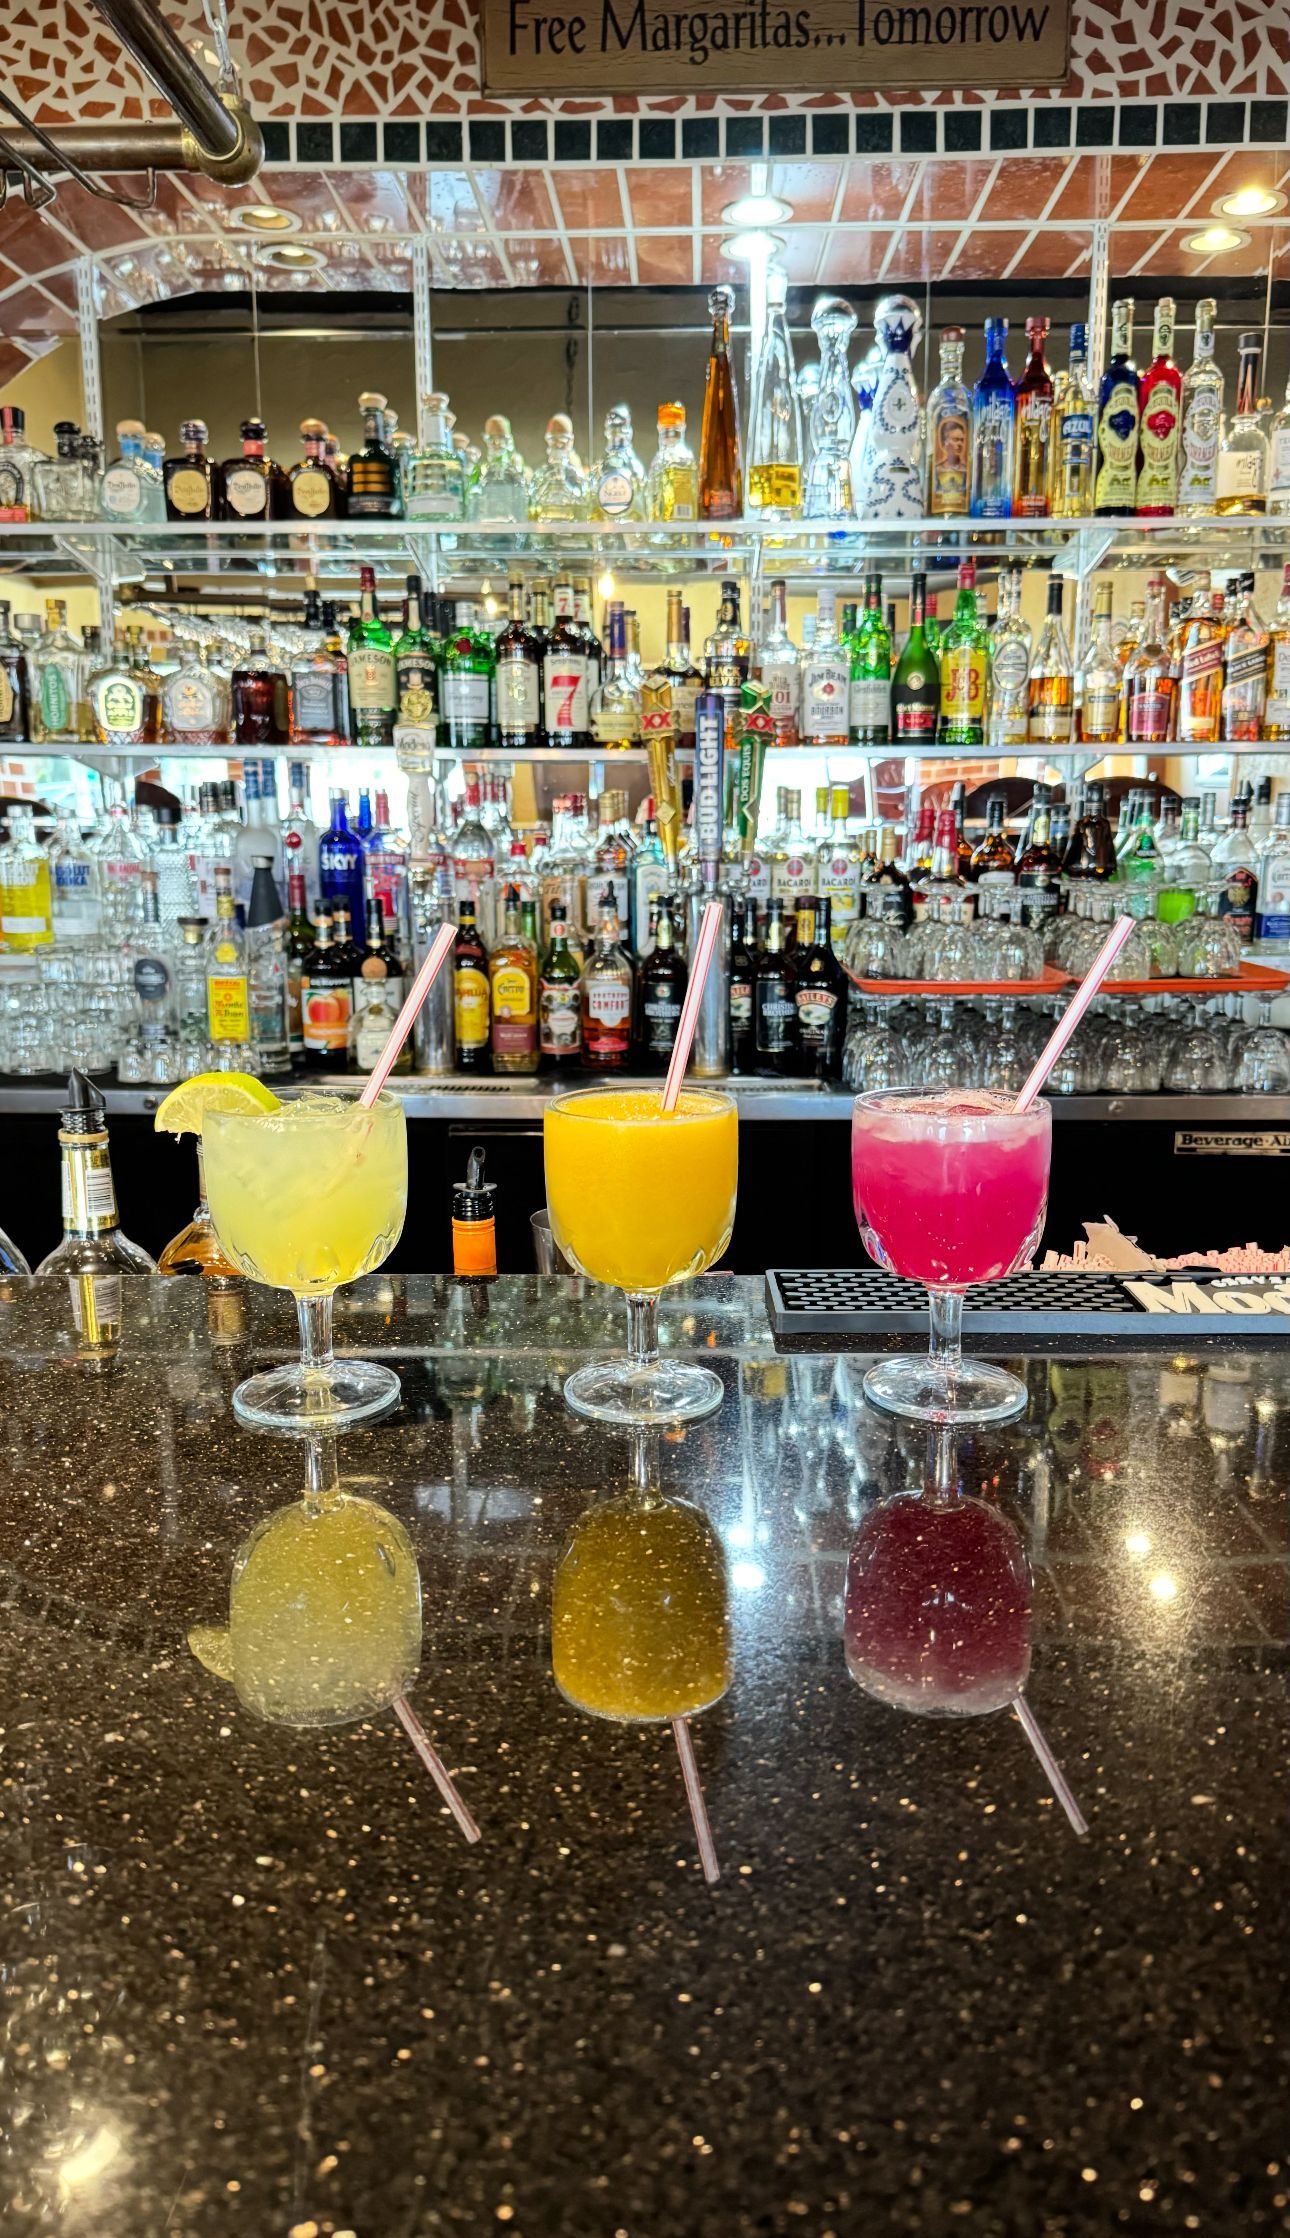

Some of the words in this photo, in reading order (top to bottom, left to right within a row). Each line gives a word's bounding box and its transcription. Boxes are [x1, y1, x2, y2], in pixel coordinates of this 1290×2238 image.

[508, 0, 587, 55] Free
[1062, 419, 1092, 433] AZUL
[559, 597, 568, 614] 7
[350, 653, 392, 668] JAMESON
[711, 665, 741, 676] LACK
[809, 672, 825, 687] JIM
[825, 668, 848, 686] BEAM
[48, 673, 59, 726] HORNITOS
[551, 675, 581, 727] 7
[641, 711, 673, 731] XX
[743, 713, 776, 734] XX
[699, 715, 719, 787] LIGHT
[741, 744, 753, 778] EQUIS
[740, 778, 751, 802] DOS
[699, 788, 719, 839] BUD
[320, 853, 358, 871] SKYY
[776, 878, 812, 888] BACARDI
[821, 877, 856, 887] BACARDI
[798, 991, 834, 1007] BAILEYS
